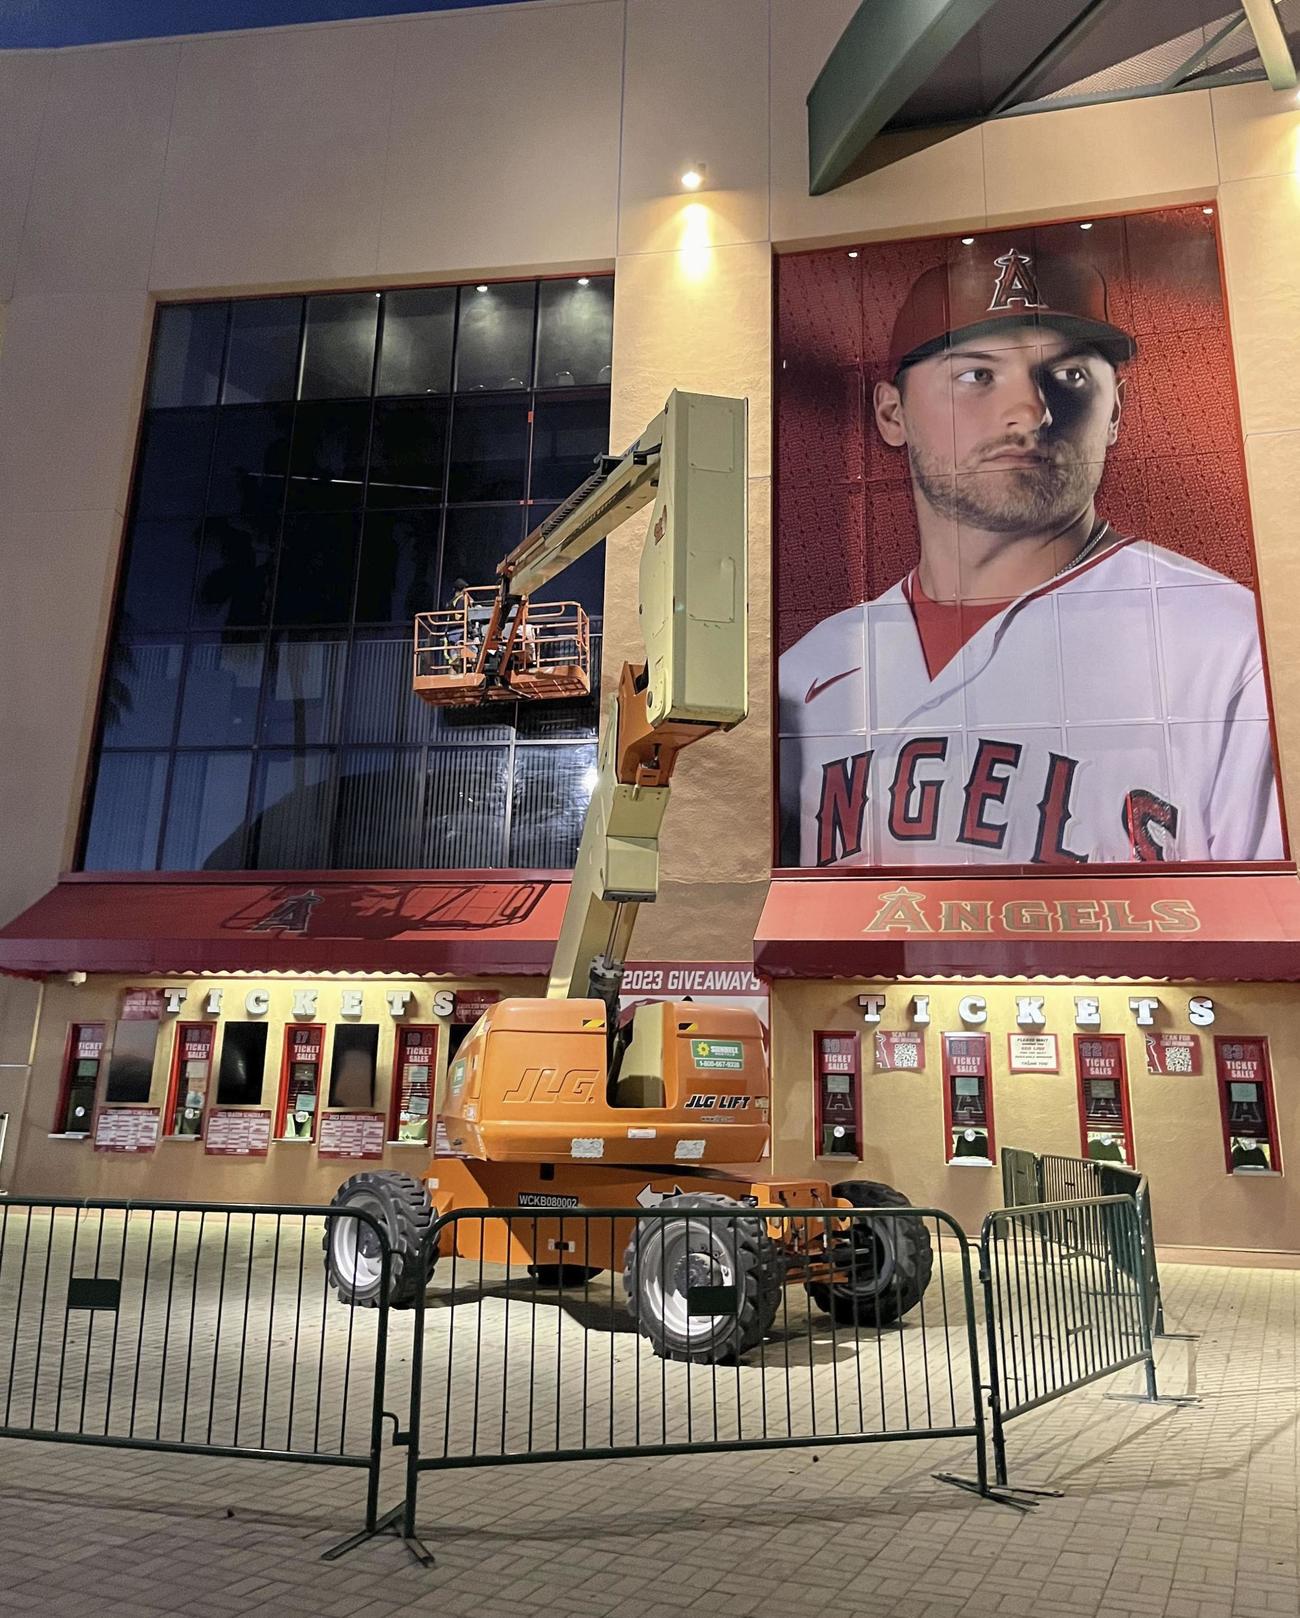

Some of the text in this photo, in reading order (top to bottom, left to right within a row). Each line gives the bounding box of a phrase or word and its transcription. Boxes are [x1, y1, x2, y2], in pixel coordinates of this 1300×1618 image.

[863, 886, 1201, 932] ANGELS
[621, 970, 761, 991] 2023 GIVEAWAYS
[164, 988, 455, 1017] TICKETS
[858, 994, 1216, 1027] TICKETS
[185, 1043, 210, 1051] TICKET
[294, 1045, 320, 1053] TICKET
[406, 1047, 432, 1055] TICKET
[824, 1054, 851, 1063] TICKET
[952, 1057, 981, 1065] TICKET
[1085, 1058, 1115, 1067] TICKET
[956, 1065, 978, 1073] SALES
[1225, 1061, 1257, 1070] TICKET
[1090, 1067, 1112, 1076] SALES
[1231, 1070, 1255, 1079] SALES
[684, 1094, 751, 1110] JLG LIFT
[519, 1194, 577, 1209] WCKB080002
